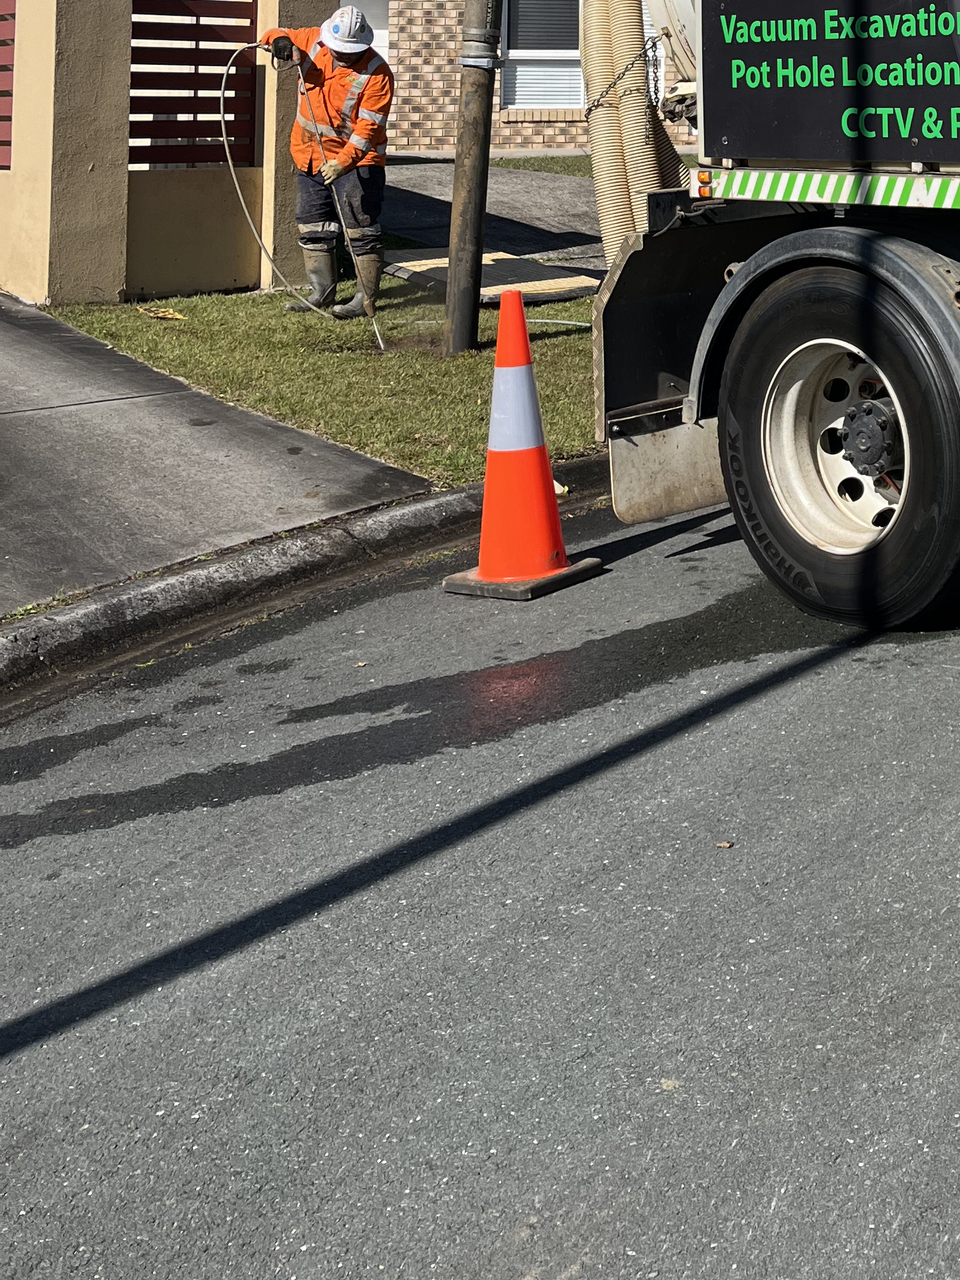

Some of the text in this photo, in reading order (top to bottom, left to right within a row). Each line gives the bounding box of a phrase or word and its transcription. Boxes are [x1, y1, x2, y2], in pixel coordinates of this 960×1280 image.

[720, 14, 817, 44] Vacuum
[731, 53, 960, 88] Pot Hole Location
[841, 107, 915, 138] CCTV
[921, 107, 944, 140] &
